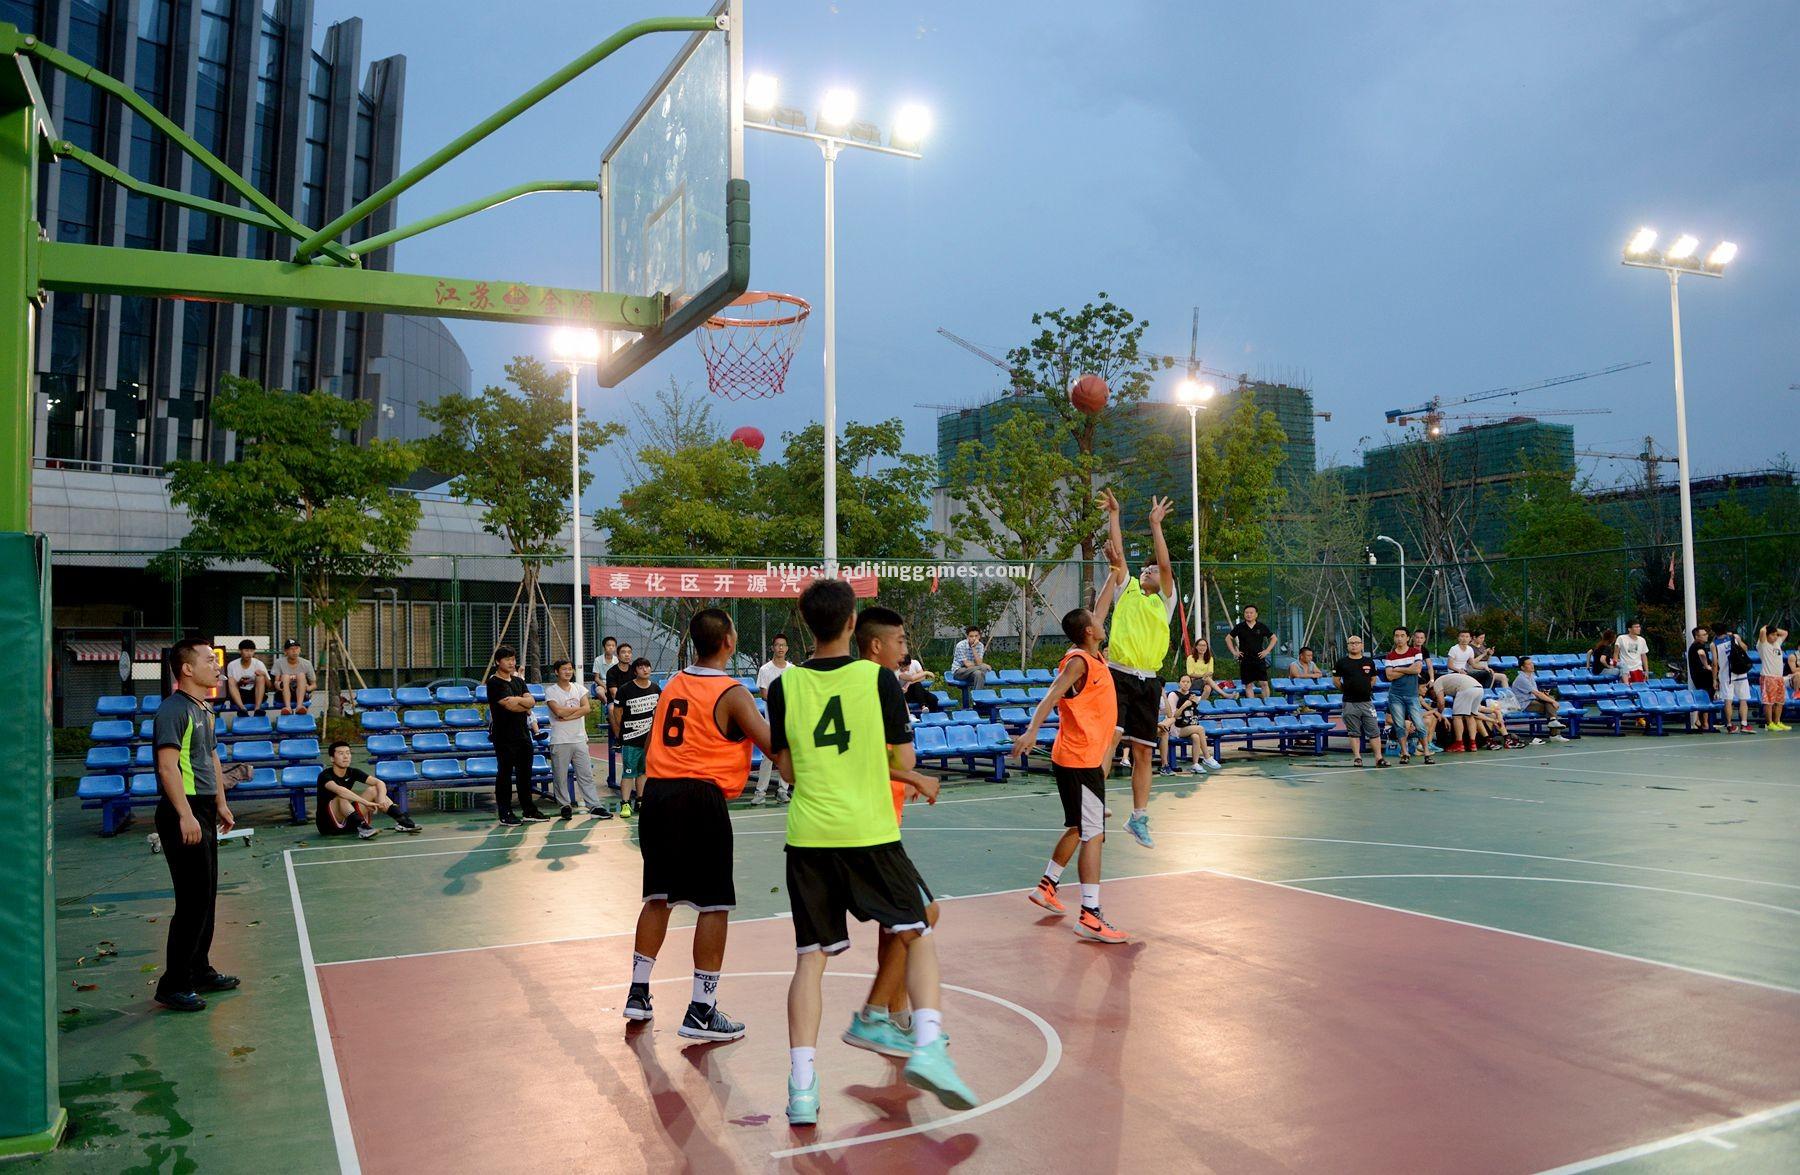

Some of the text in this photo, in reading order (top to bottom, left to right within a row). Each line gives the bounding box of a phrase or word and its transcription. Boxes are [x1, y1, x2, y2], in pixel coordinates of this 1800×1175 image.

[435, 280, 495, 311] 江苏
[662, 698, 689, 747] 6
[813, 695, 851, 755] 4
